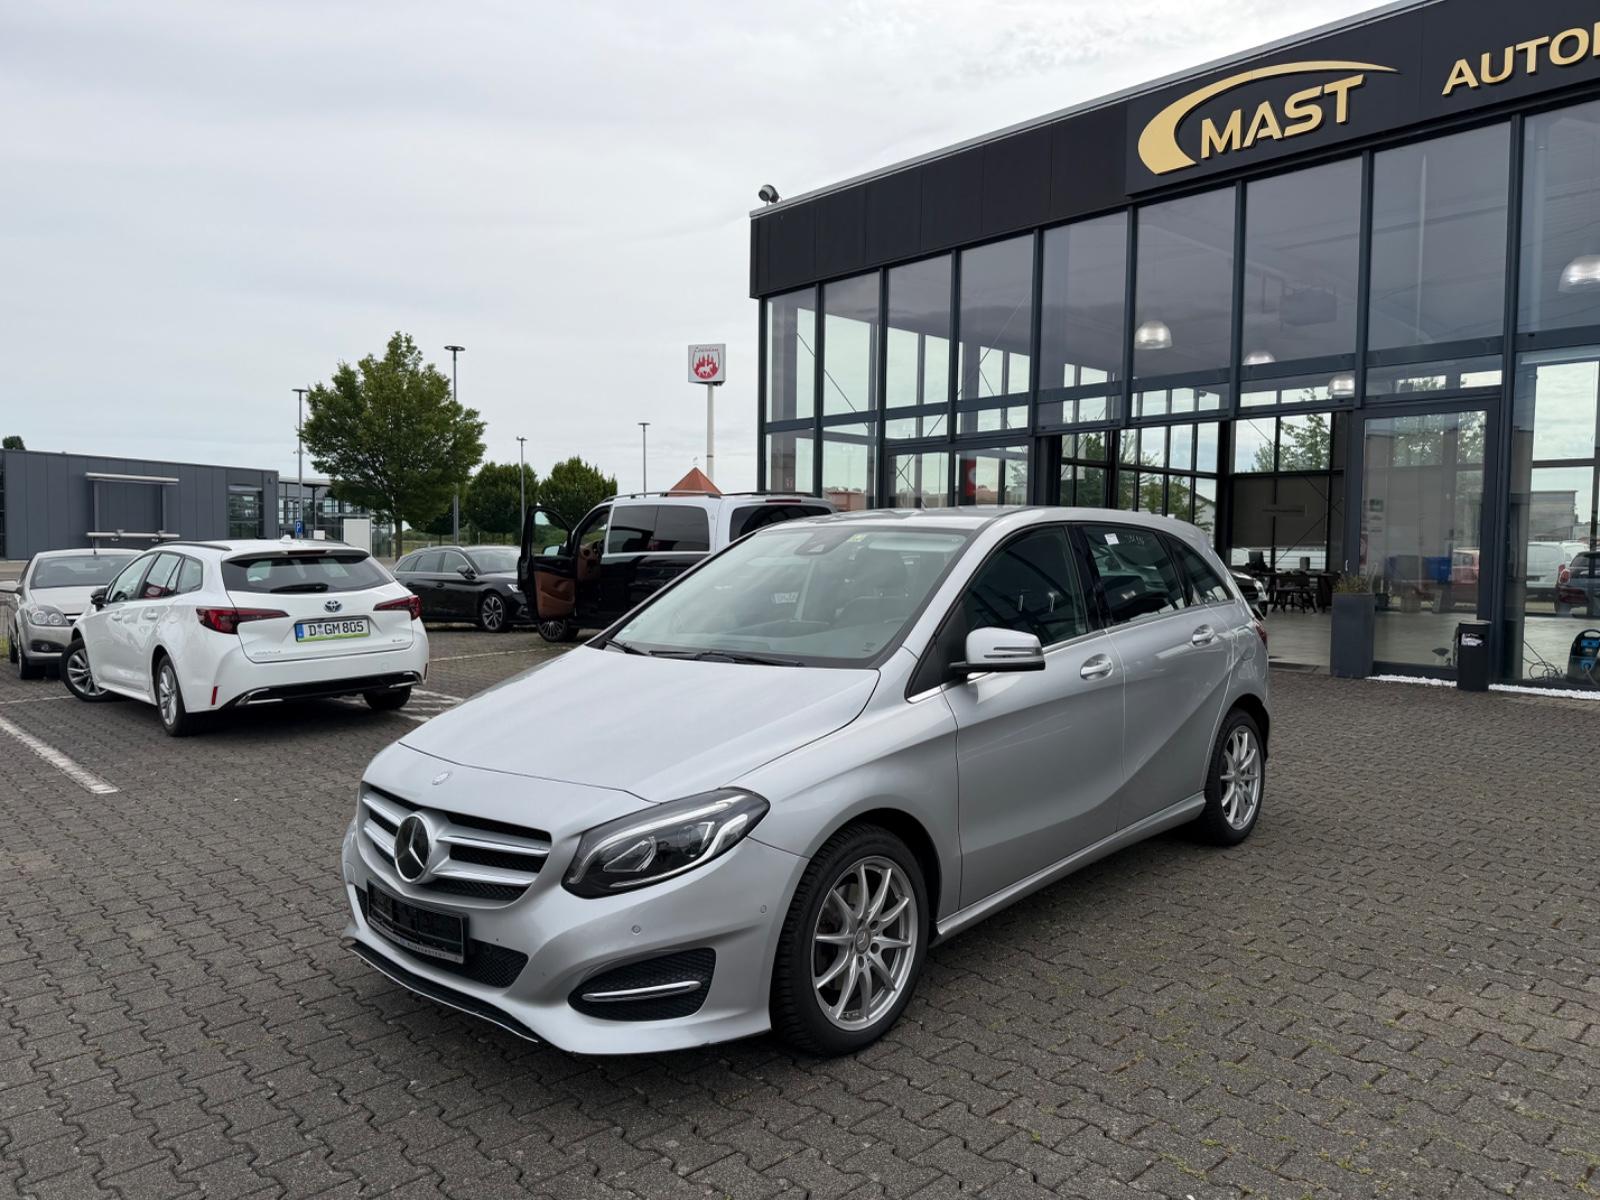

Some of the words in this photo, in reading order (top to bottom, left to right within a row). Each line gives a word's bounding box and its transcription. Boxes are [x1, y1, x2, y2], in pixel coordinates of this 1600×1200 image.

[1441, 20, 1600, 96] AUTO
[1200, 73, 1365, 160] MAST
[308, 624, 317, 636] D
[324, 622, 341, 635] GM
[342, 620, 364, 634] 805
